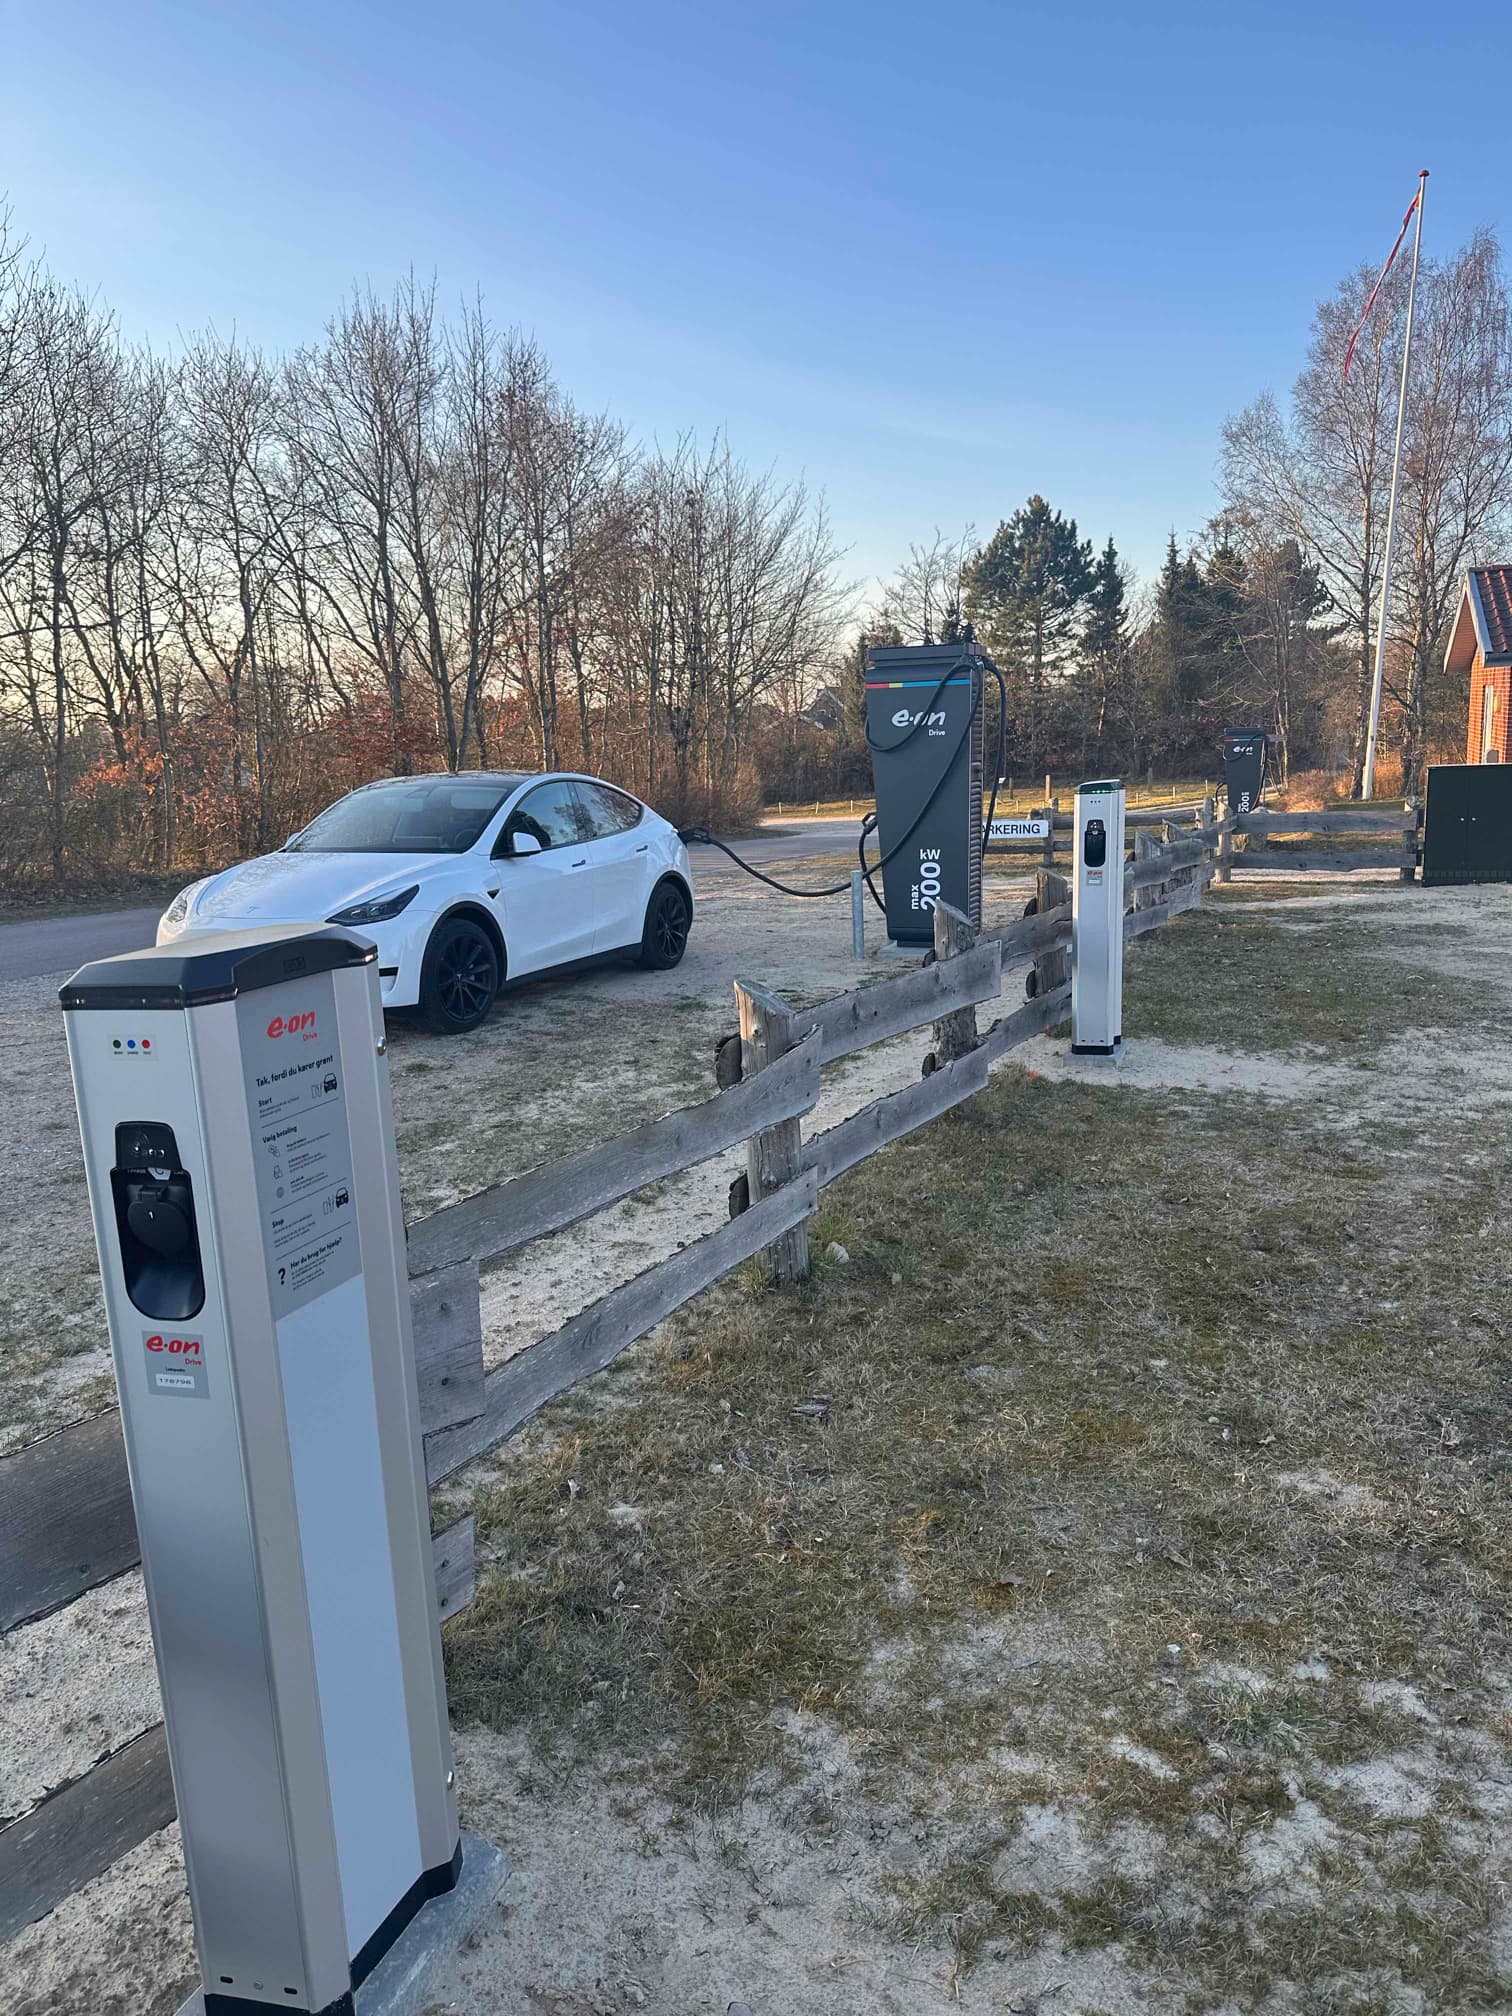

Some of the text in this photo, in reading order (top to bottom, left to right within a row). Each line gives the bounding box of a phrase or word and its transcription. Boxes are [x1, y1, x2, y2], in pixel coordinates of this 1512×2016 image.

[928, 729, 946, 737] Drive
[920, 848, 941, 911] 200 kW
[911, 884, 919, 910] max
[302, 1032, 318, 1041] Drive
[256, 1077, 271, 1088] Tak,
[271, 1070, 288, 1081] fordi
[288, 1067, 297, 1076] du
[258, 1097, 272, 1107] Start
[184, 1358, 202, 1366] Drive
